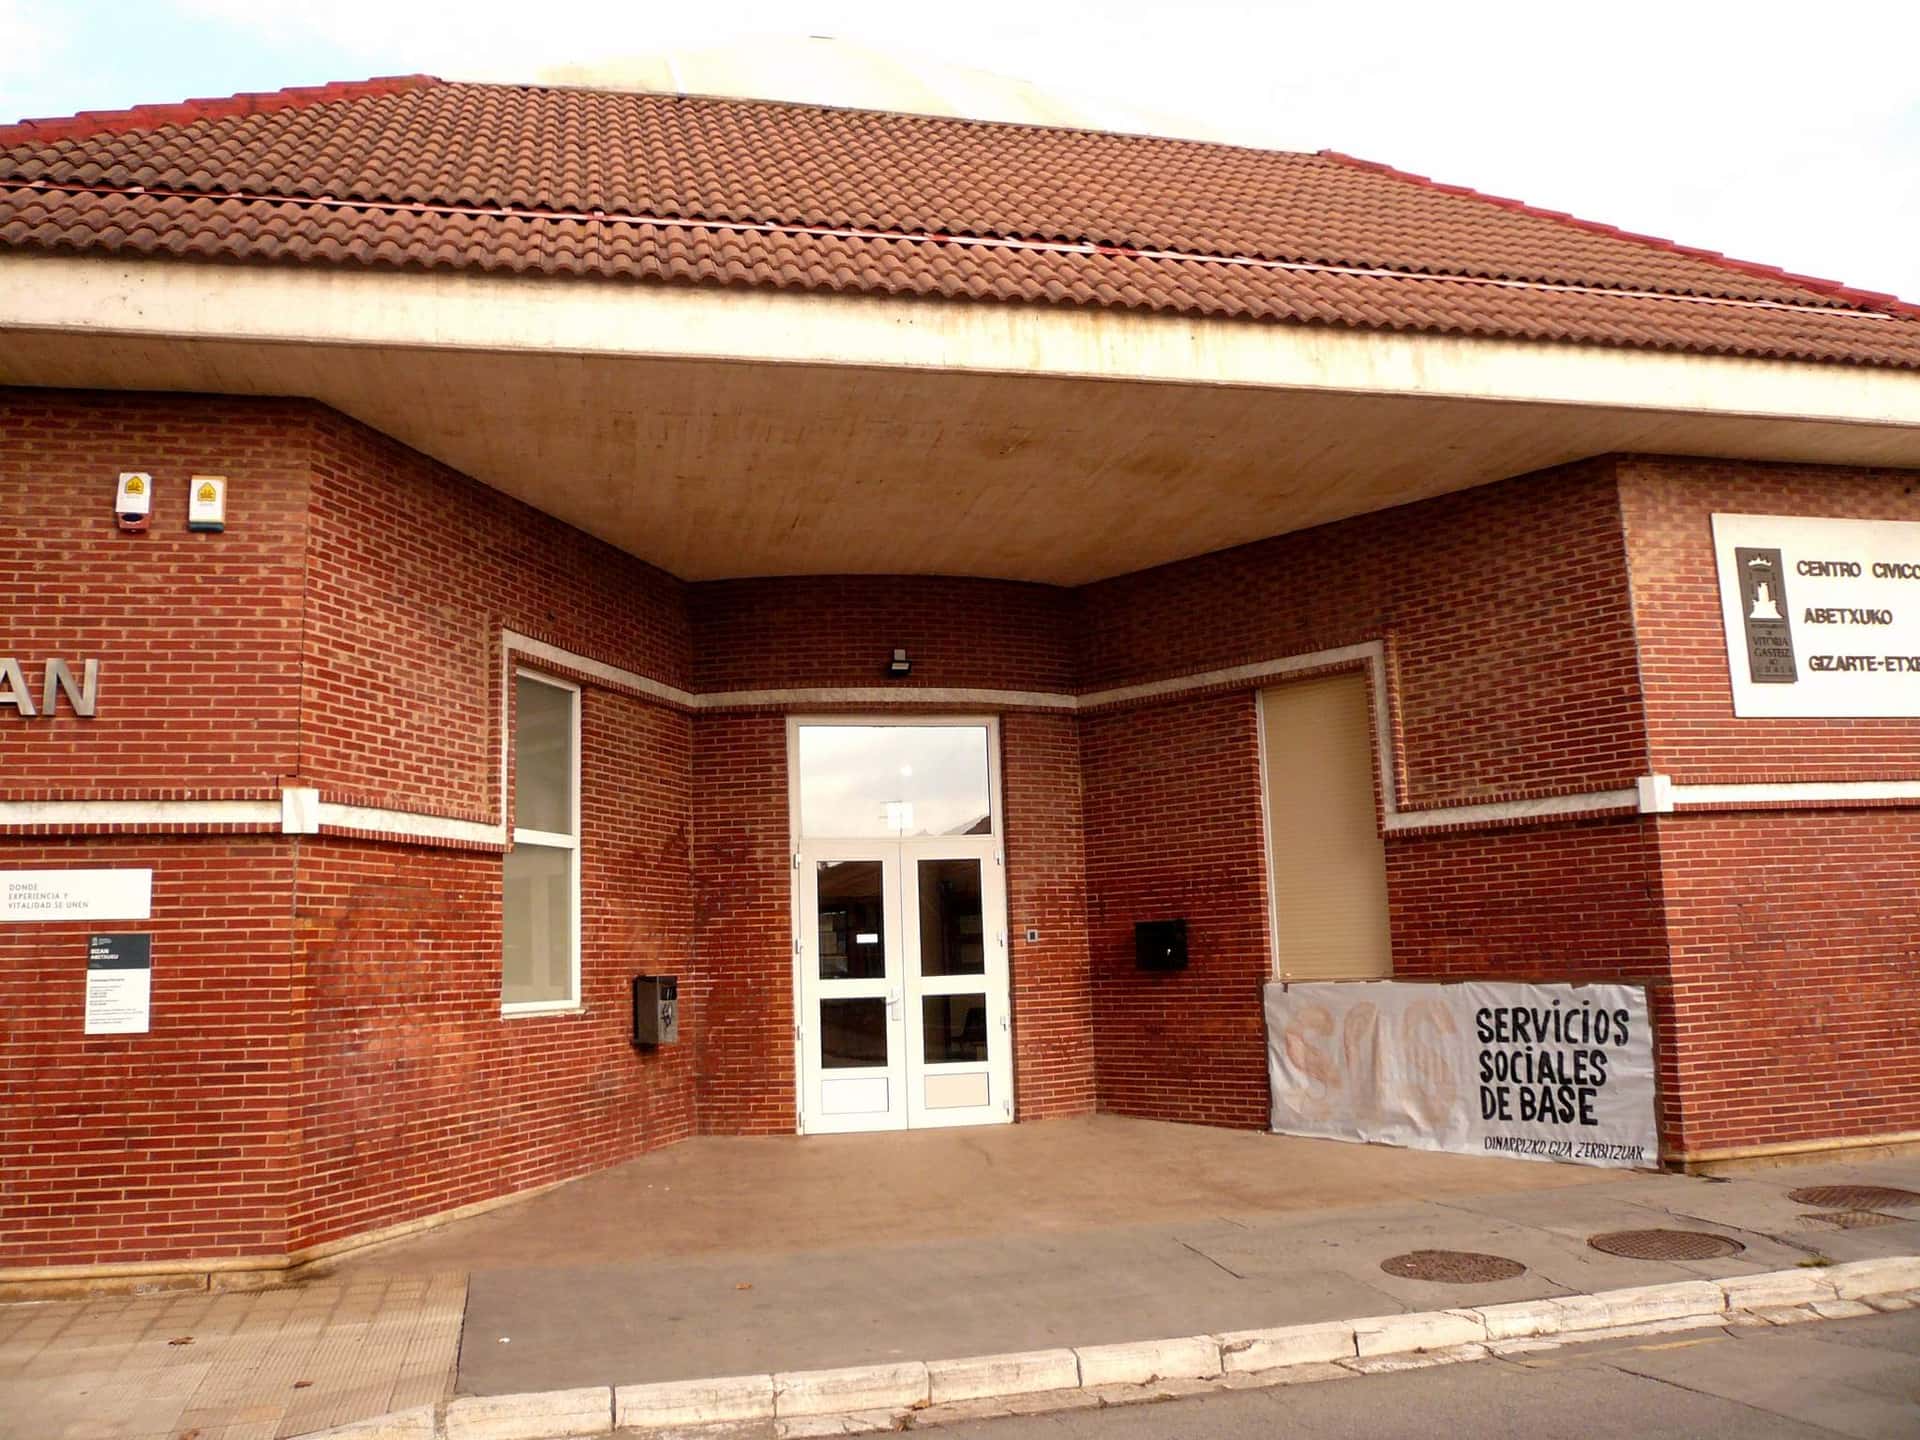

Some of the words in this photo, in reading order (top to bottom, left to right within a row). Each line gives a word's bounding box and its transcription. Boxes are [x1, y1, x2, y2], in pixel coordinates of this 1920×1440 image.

[1796, 560, 1862, 577] CENTRO
[1804, 608, 1893, 625] ABETXUKO
[9, 883, 38, 891] DONDE
[8, 892, 60, 900] EXPERIENCIA
[1480, 1085, 1513, 1120] DE
[1520, 1085, 1598, 1125] BASE
[1548, 1140, 1573, 1158] GIZA
[1575, 1142, 1645, 1161] ZERBITZUAK
